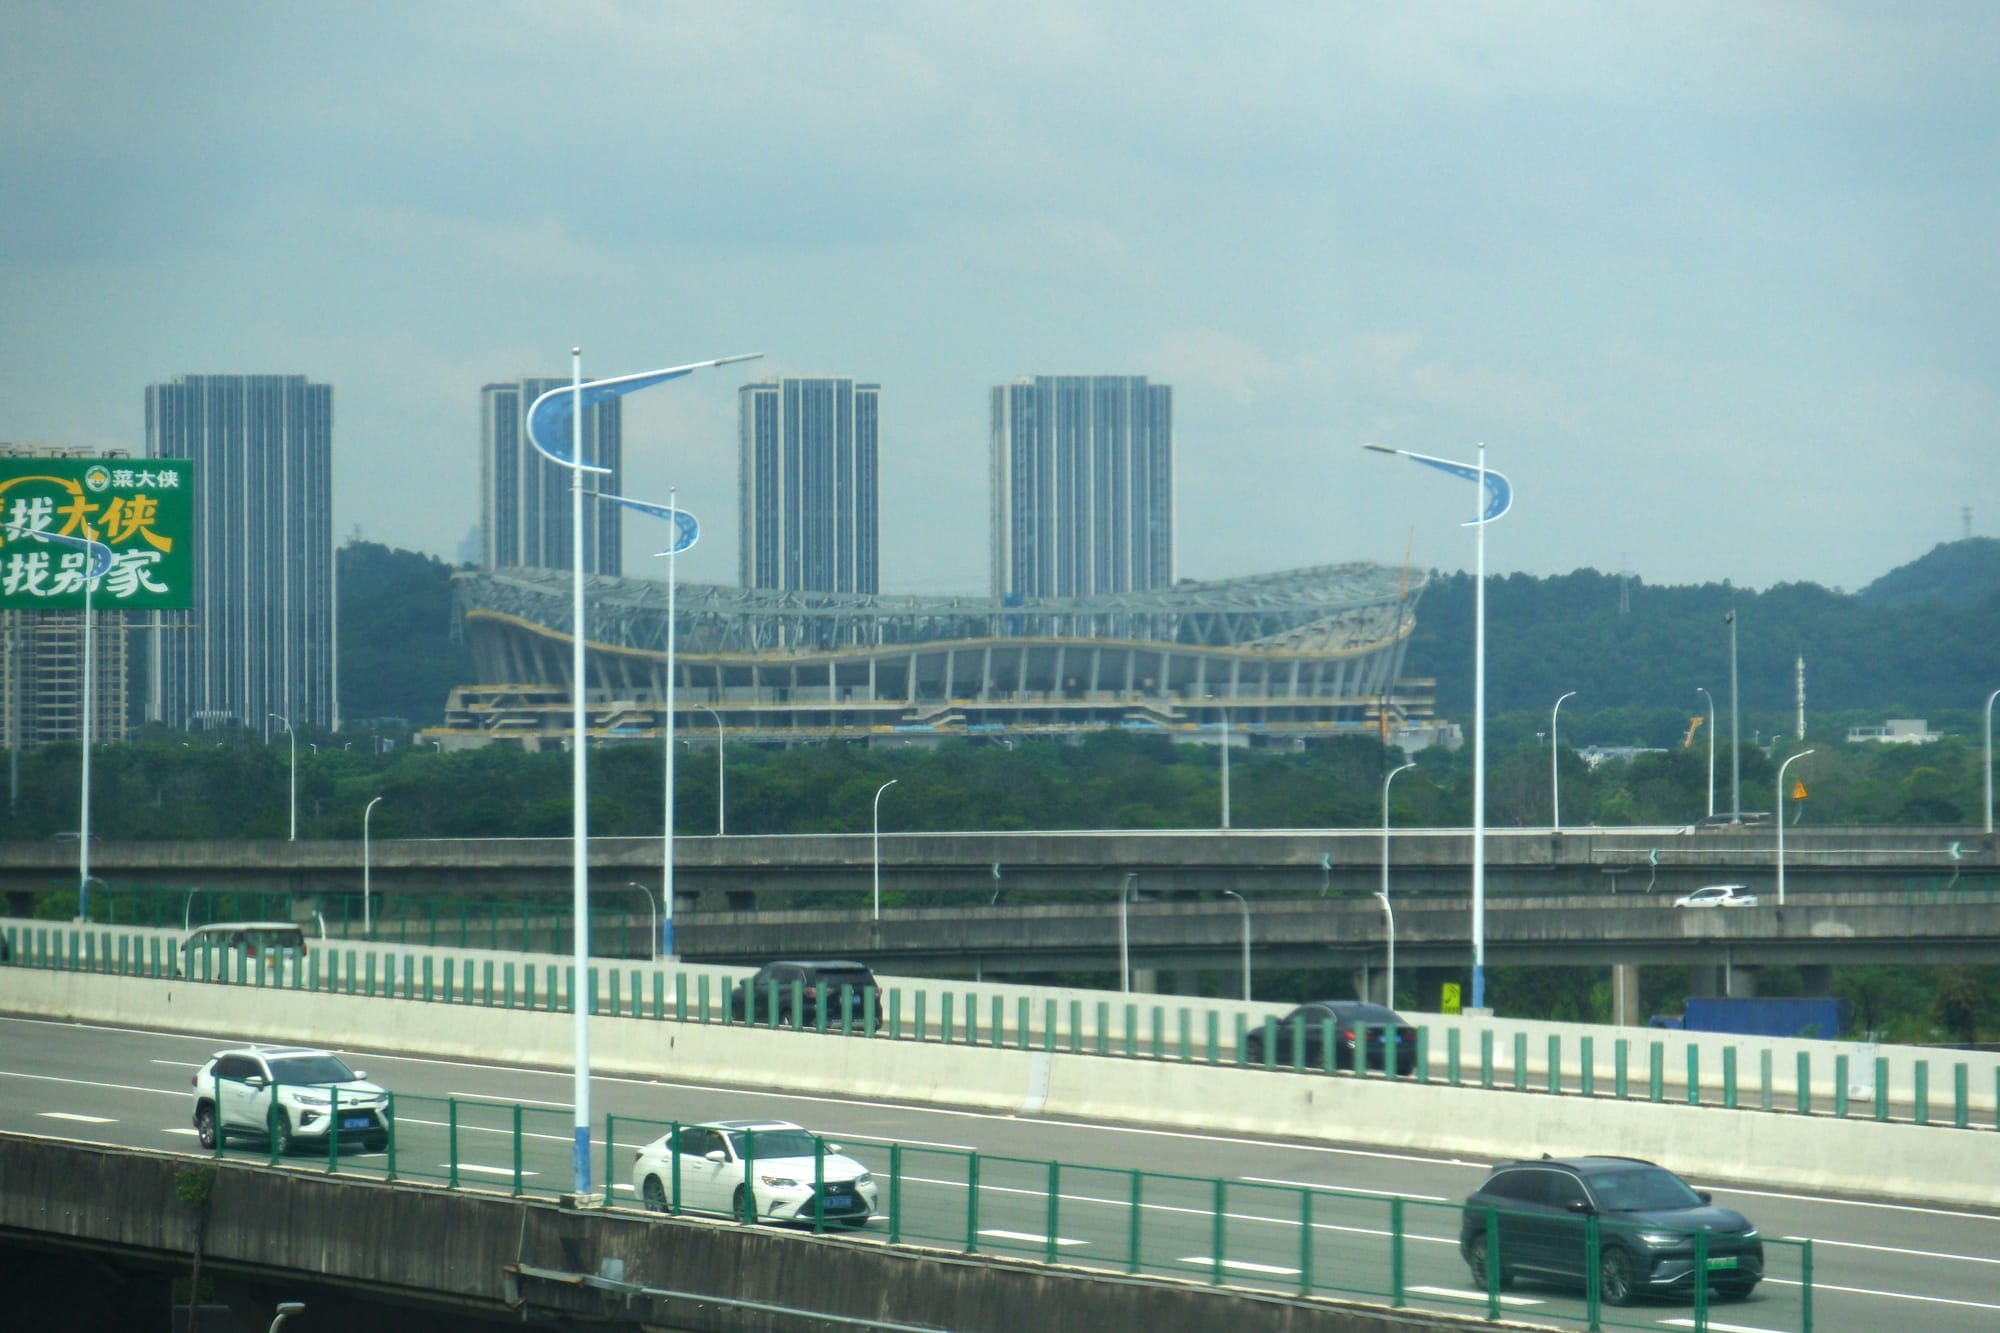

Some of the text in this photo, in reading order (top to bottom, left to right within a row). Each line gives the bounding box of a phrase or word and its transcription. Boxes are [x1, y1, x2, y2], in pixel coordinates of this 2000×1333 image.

[112, 469, 179, 488] 菜大侠
[0, 494, 172, 553] 找大侠
[0, 549, 169, 598] 找别家
